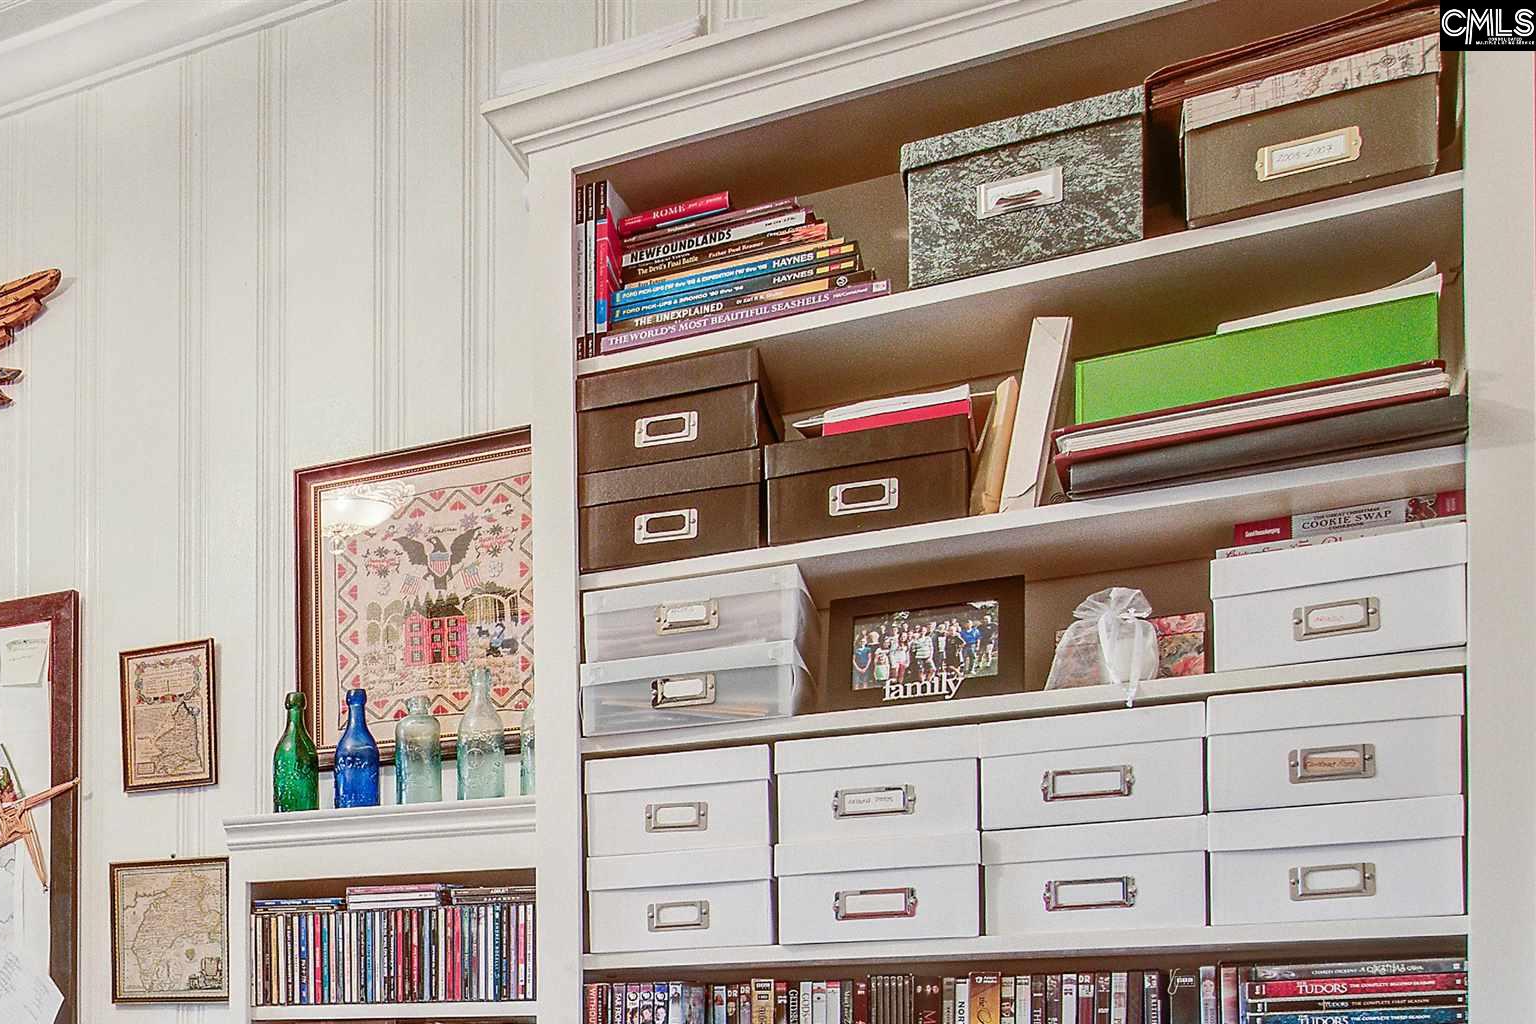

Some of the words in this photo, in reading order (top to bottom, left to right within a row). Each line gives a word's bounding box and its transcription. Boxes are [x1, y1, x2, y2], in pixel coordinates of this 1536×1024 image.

[652, 204, 685, 220] ROME
[630, 228, 732, 264] NEWFOUNDLANDS
[772, 252, 815, 268] HAYNES
[772, 269, 814, 285] HAYNES
[608, 334, 631, 346] THE
[631, 326, 676, 340] WORLD'S
[679, 319, 707, 332] MOST
[710, 305, 770, 325] BEAUTIFUL
[771, 294, 829, 312] SEASHELLS
[634, 316, 656, 328] THE
[656, 302, 724, 323] UNEXPLAINED
[1301, 515, 1352, 531] COOKIE
[1354, 509, 1392, 523] SWAP
[882, 667, 965, 702] family
[1297, 983, 1348, 996] TUDORS
